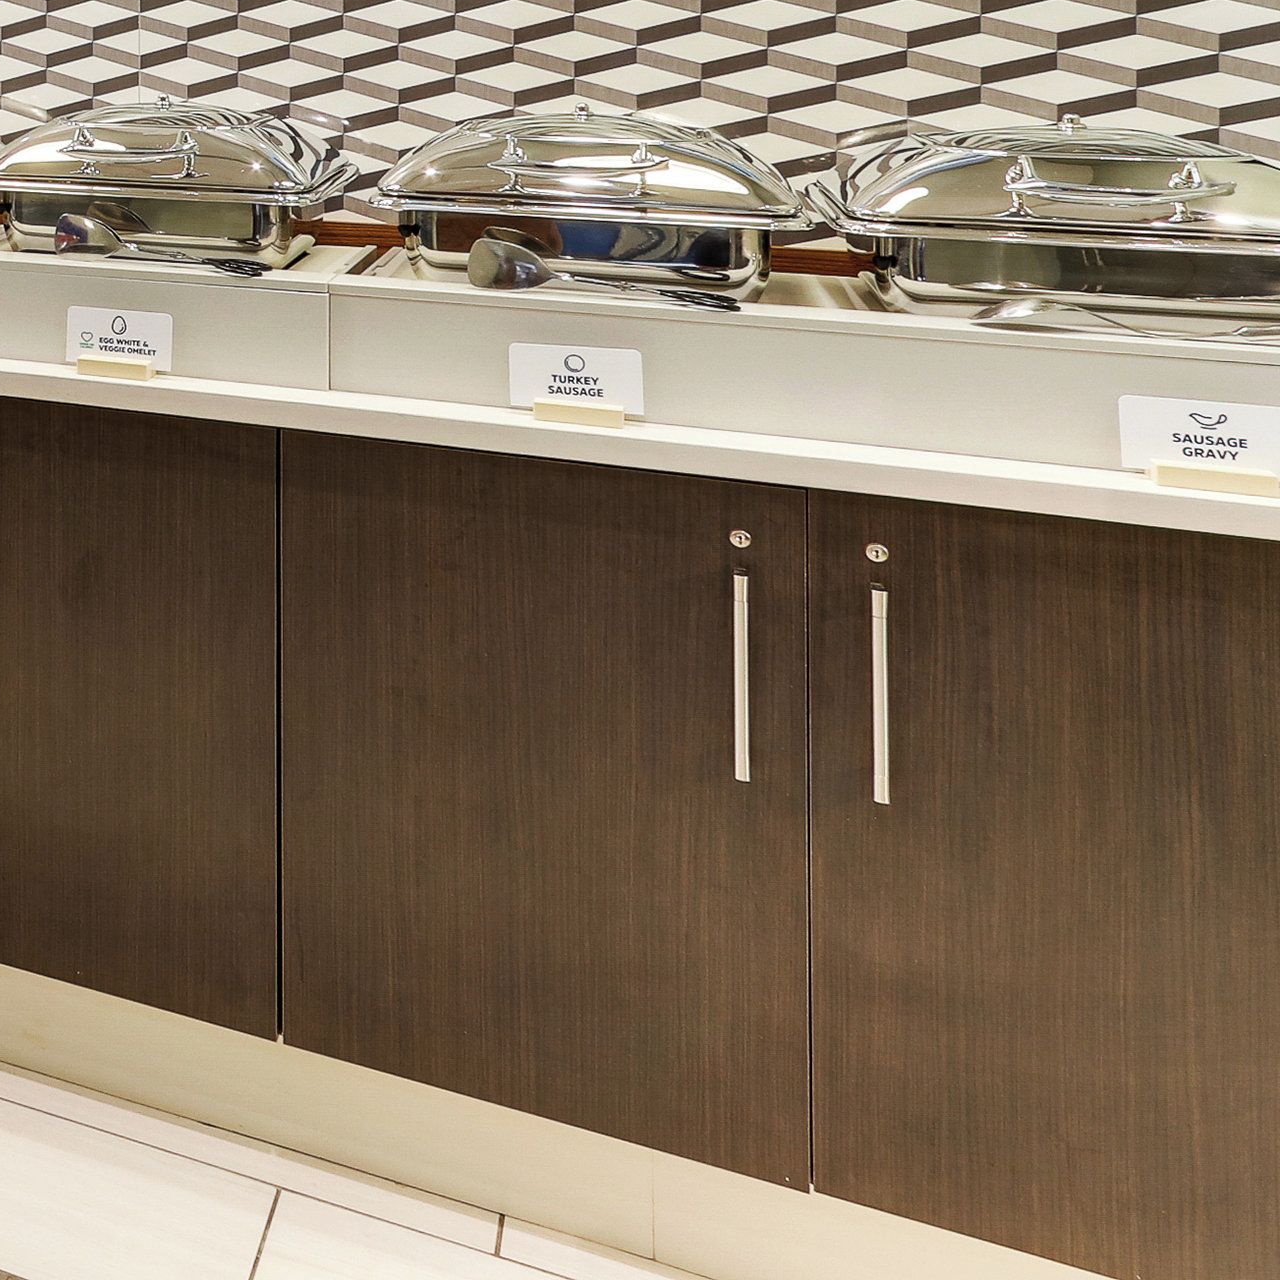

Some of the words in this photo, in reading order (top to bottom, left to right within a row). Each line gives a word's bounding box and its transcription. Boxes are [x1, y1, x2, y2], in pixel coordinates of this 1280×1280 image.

[98, 337, 115, 345] EGG
[115, 338, 141, 347] WHITE
[142, 340, 149, 348] &
[98, 345, 126, 354] VEGGIE
[127, 347, 157, 356] OMELET
[551, 374, 599, 386] TURKEY
[547, 385, 604, 398] SAUSAGE
[1172, 432, 1248, 449] SAUSAGE
[1182, 446, 1239, 461] GRAVY
